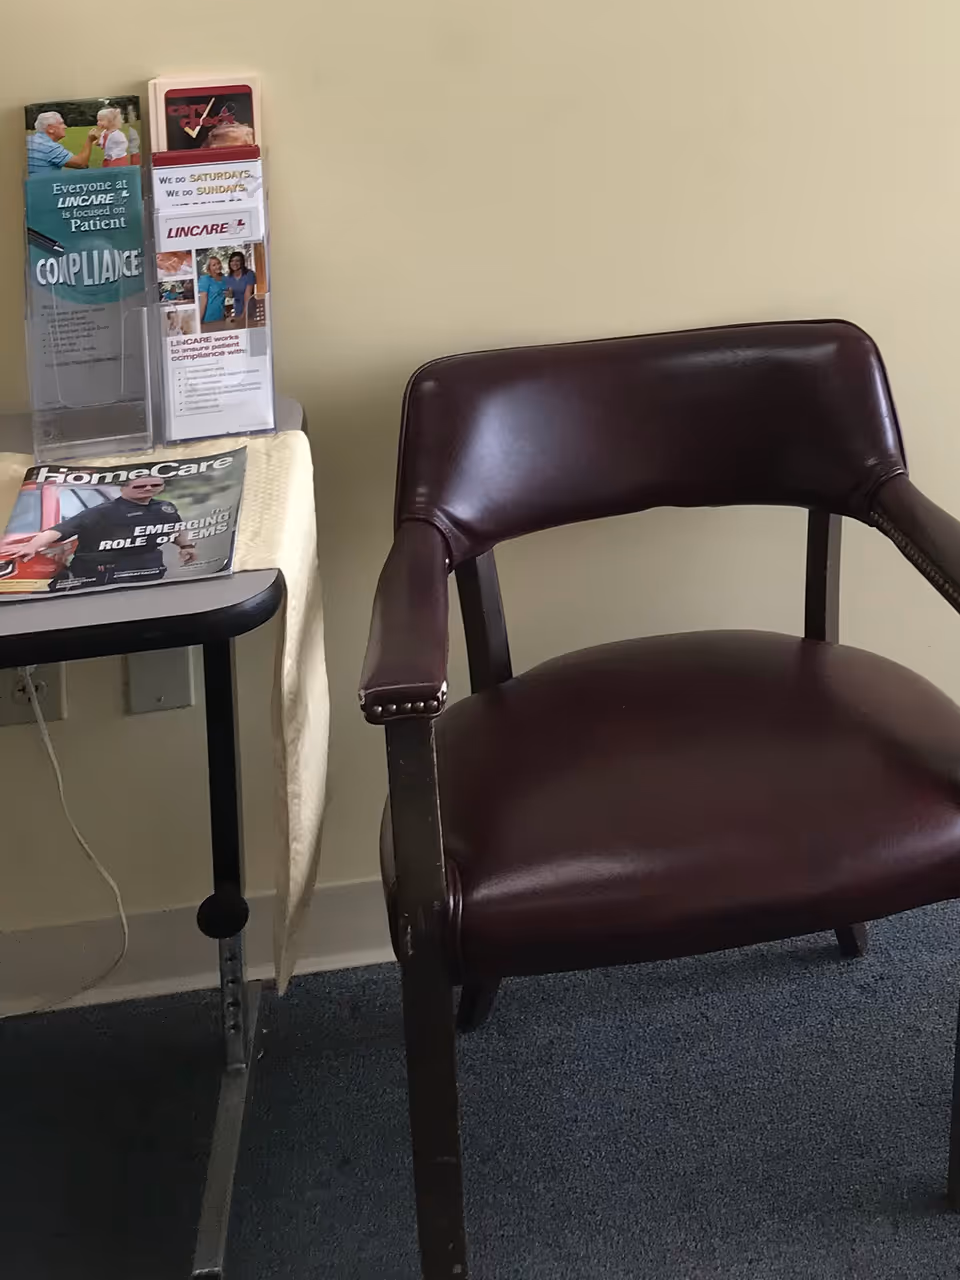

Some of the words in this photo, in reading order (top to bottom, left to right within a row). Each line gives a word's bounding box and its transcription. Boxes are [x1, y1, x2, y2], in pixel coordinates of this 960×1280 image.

[189, 169, 253, 182] SATURDAYS.
[52, 182, 112, 195] Everyone
[116, 179, 128, 189] at
[57, 193, 115, 208] LINCARE
[62, 210, 71, 219] is
[73, 206, 111, 218] focused
[113, 206, 126, 214] on
[70, 217, 127, 232] Patient
[167, 222, 229, 239] LINCARE
[213, 334, 239, 342] works
[181, 345, 210, 353] ensure
[211, 341, 240, 351] patient
[171, 351, 225, 362] compliance
[36, 455, 234, 484] HomeCare
[134, 512, 230, 536] EMERGING
[99, 537, 147, 551] ROLE
[156, 532, 179, 544] of
[187, 523, 229, 540] EMS
